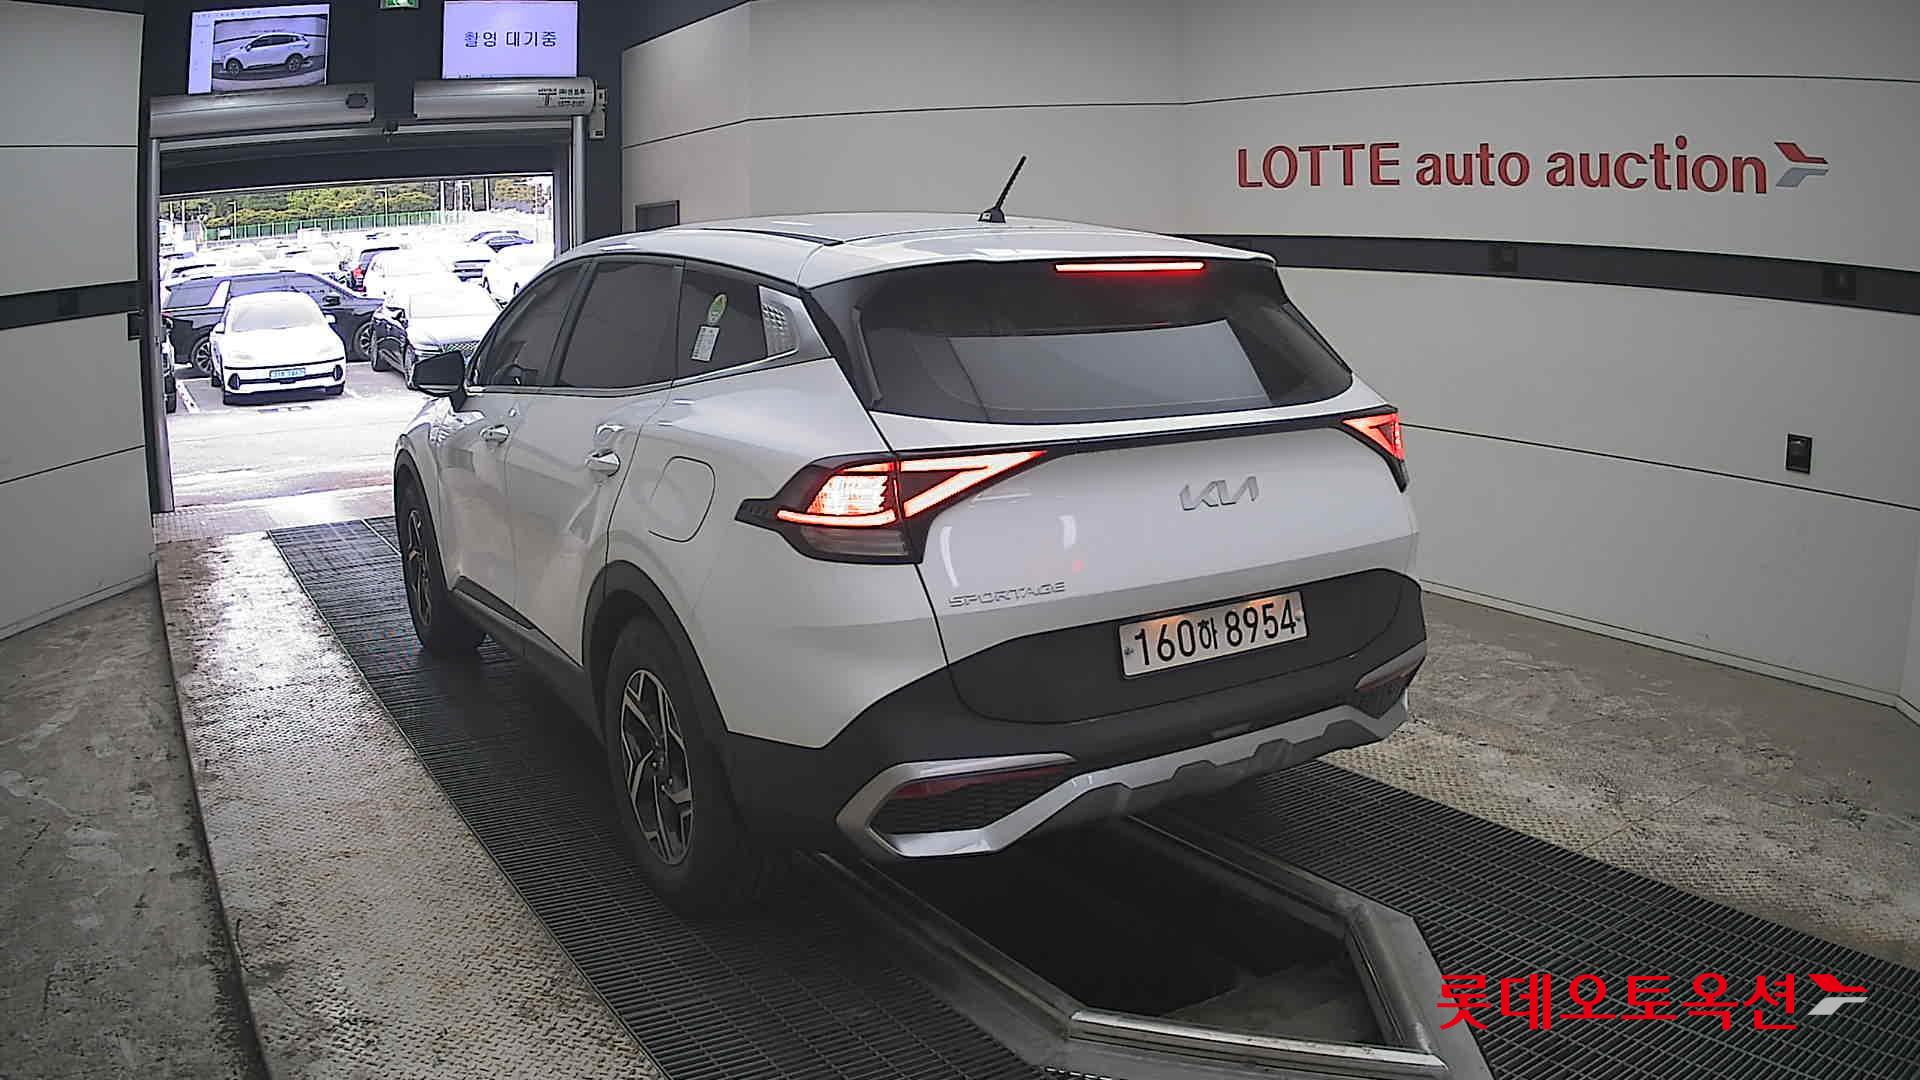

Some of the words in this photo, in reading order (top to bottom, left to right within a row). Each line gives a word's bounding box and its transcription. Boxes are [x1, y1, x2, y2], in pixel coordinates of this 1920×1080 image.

[506, 31, 557, 48] 대기중
[1236, 142, 1400, 189] LOTTE
[1415, 142, 1530, 187] auto
[1546, 135, 1767, 194] auction
[949, 581, 1065, 608] SPORTAGE
[1134, 617, 1218, 666] 160하
[1225, 599, 1297, 647] 8954
